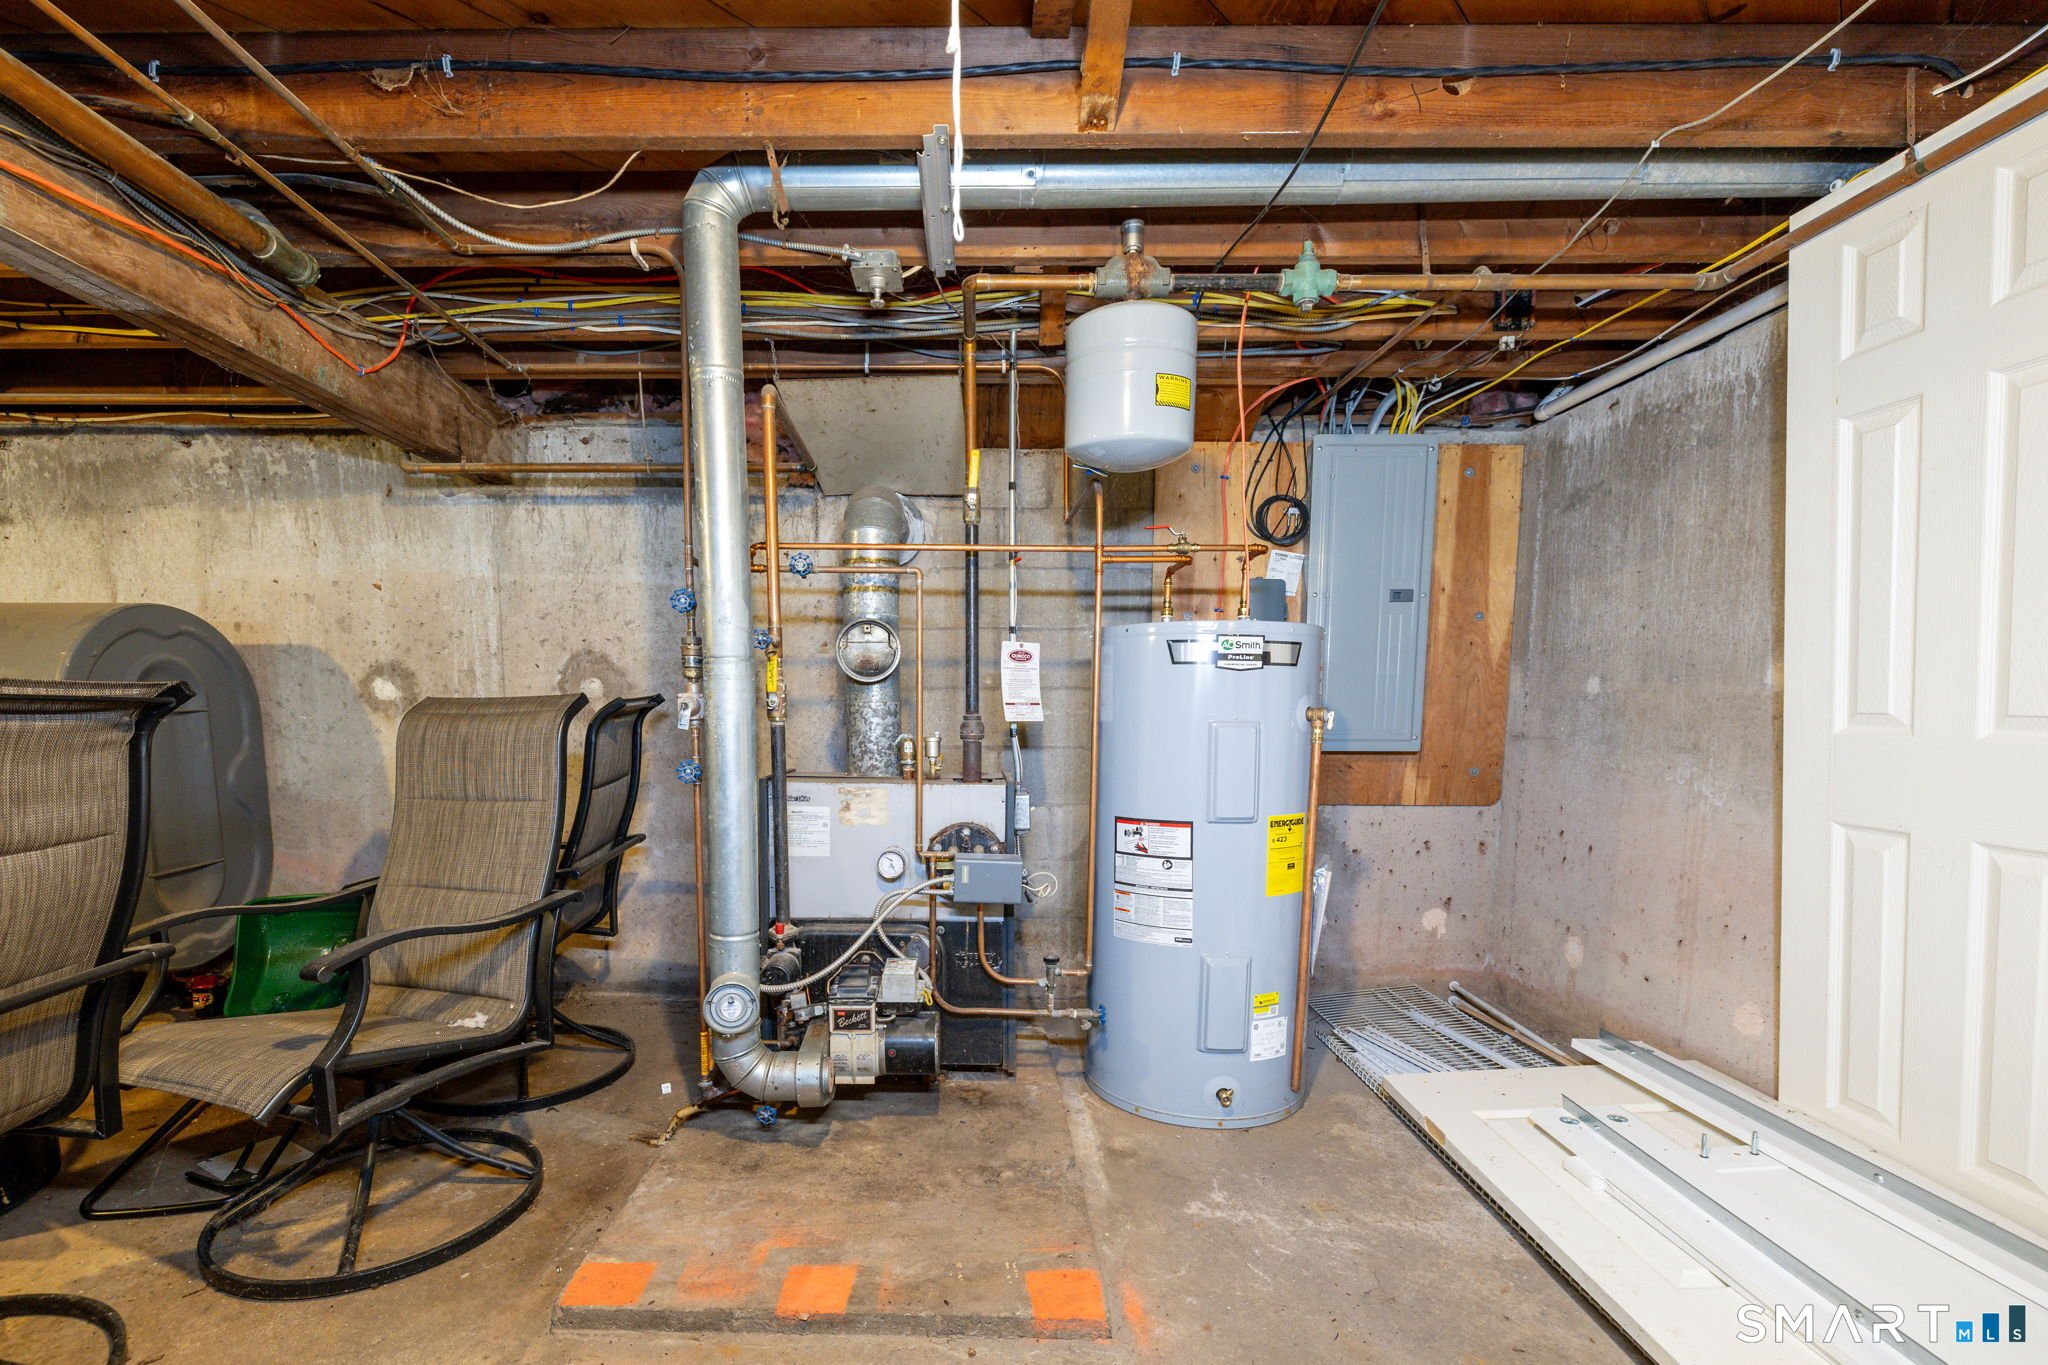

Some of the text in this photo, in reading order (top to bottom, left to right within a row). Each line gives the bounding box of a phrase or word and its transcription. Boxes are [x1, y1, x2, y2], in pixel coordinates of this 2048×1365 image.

[1158, 374, 1188, 385] WARNING
[1235, 641, 1261, 650] Smith
[1275, 835, 1288, 843] 423
[837, 1011, 868, 1028] Beckett
